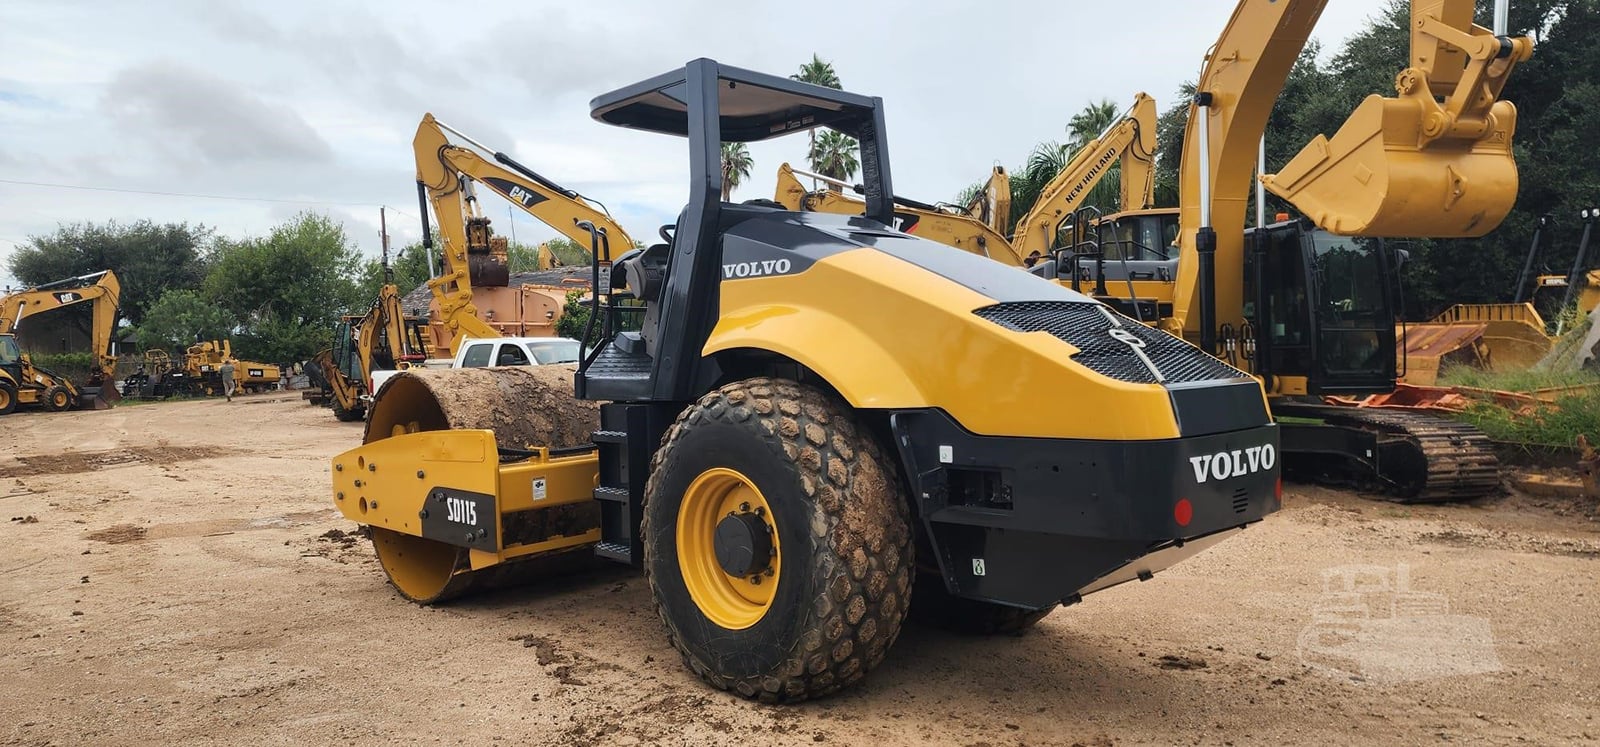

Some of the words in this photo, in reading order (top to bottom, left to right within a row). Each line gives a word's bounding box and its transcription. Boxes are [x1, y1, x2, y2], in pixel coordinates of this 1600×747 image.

[1065, 182, 1084, 204] NEW
[1082, 147, 1116, 185] HOLLAND
[509, 185, 533, 206] CAT
[722, 258, 792, 279] VOLVO
[60, 292, 74, 304] CAT
[1189, 443, 1276, 484] VOLVO
[446, 497, 477, 526] SD115
